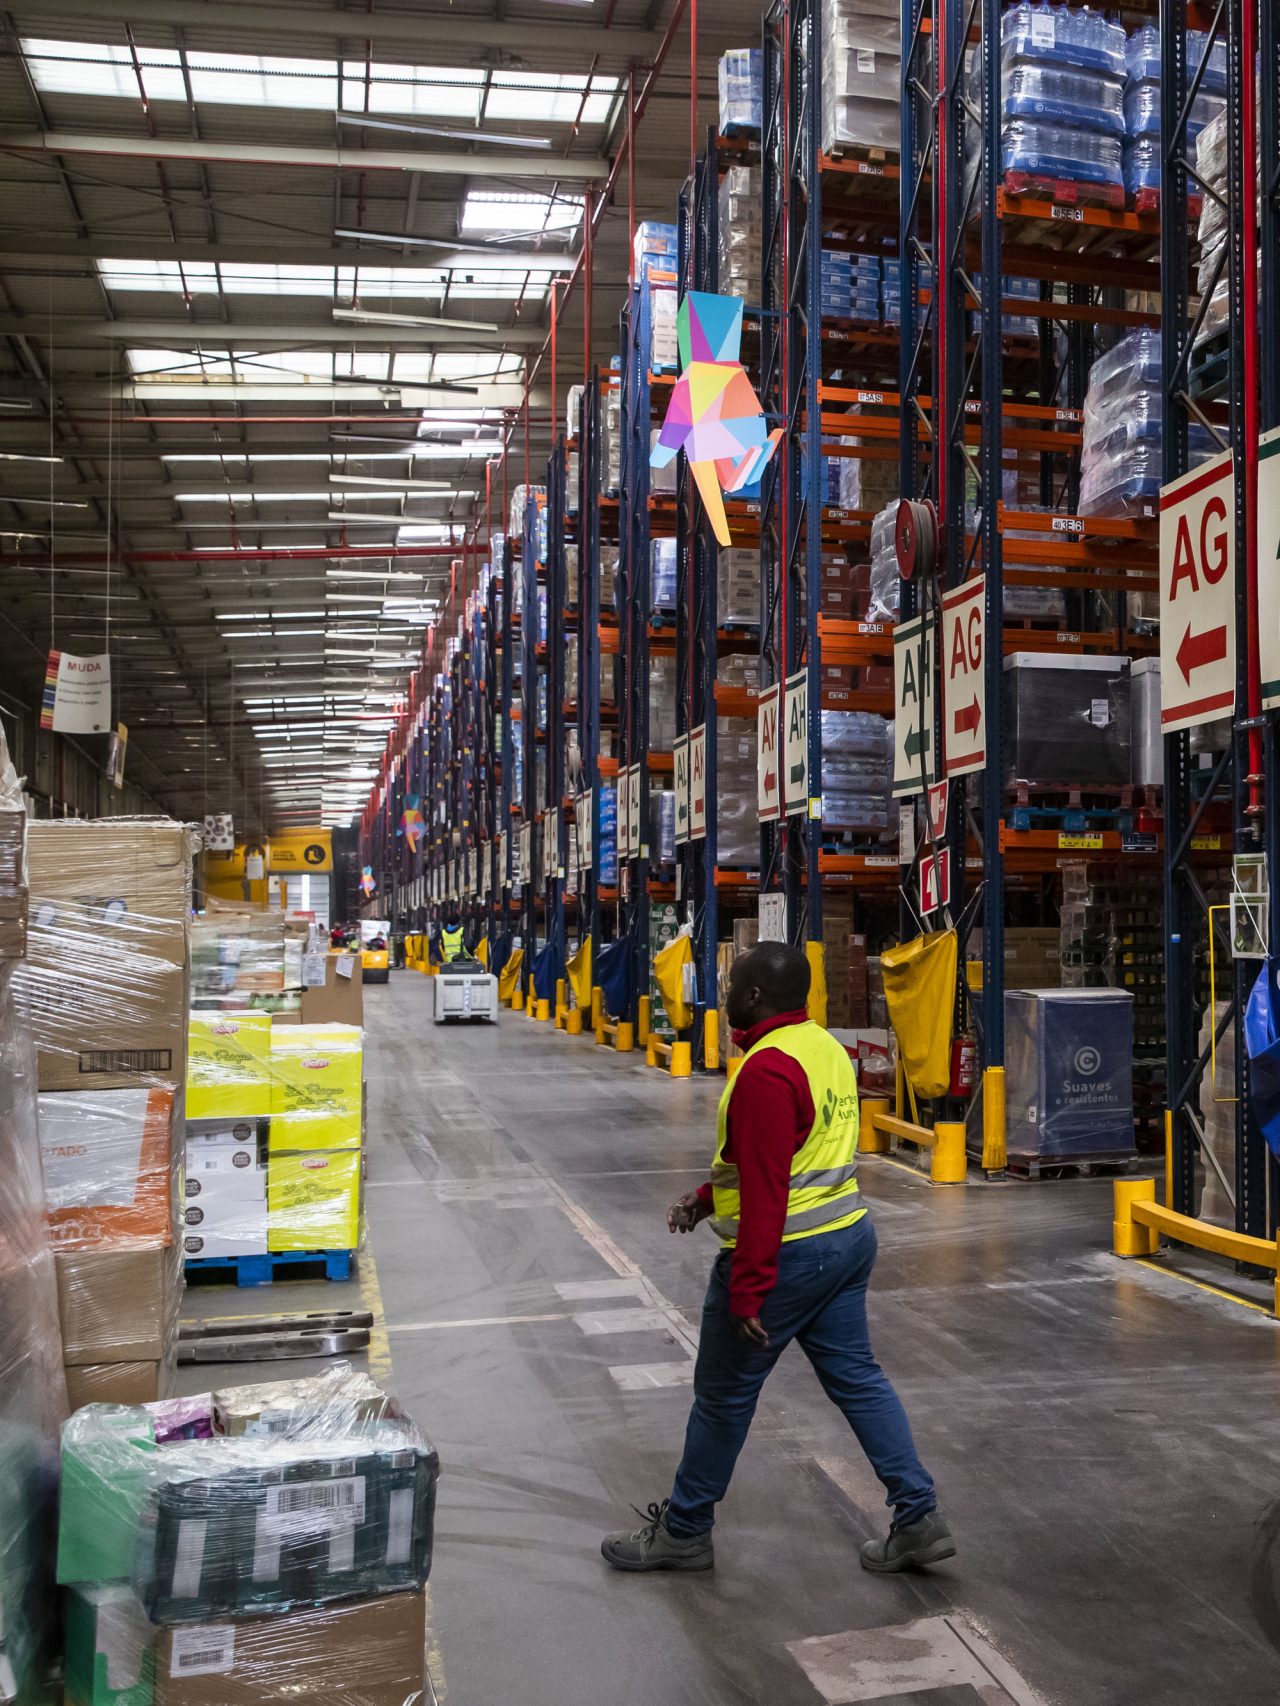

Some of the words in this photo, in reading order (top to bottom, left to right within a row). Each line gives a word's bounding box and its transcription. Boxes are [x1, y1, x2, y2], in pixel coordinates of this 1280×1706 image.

[1169, 496, 1228, 602] AG
[67, 661, 102, 672] MUDA
[950, 606, 982, 680] AG
[902, 640, 930, 708] AH
[789, 690, 806, 743] AH
[1063, 1080, 1112, 1094] Suaves
